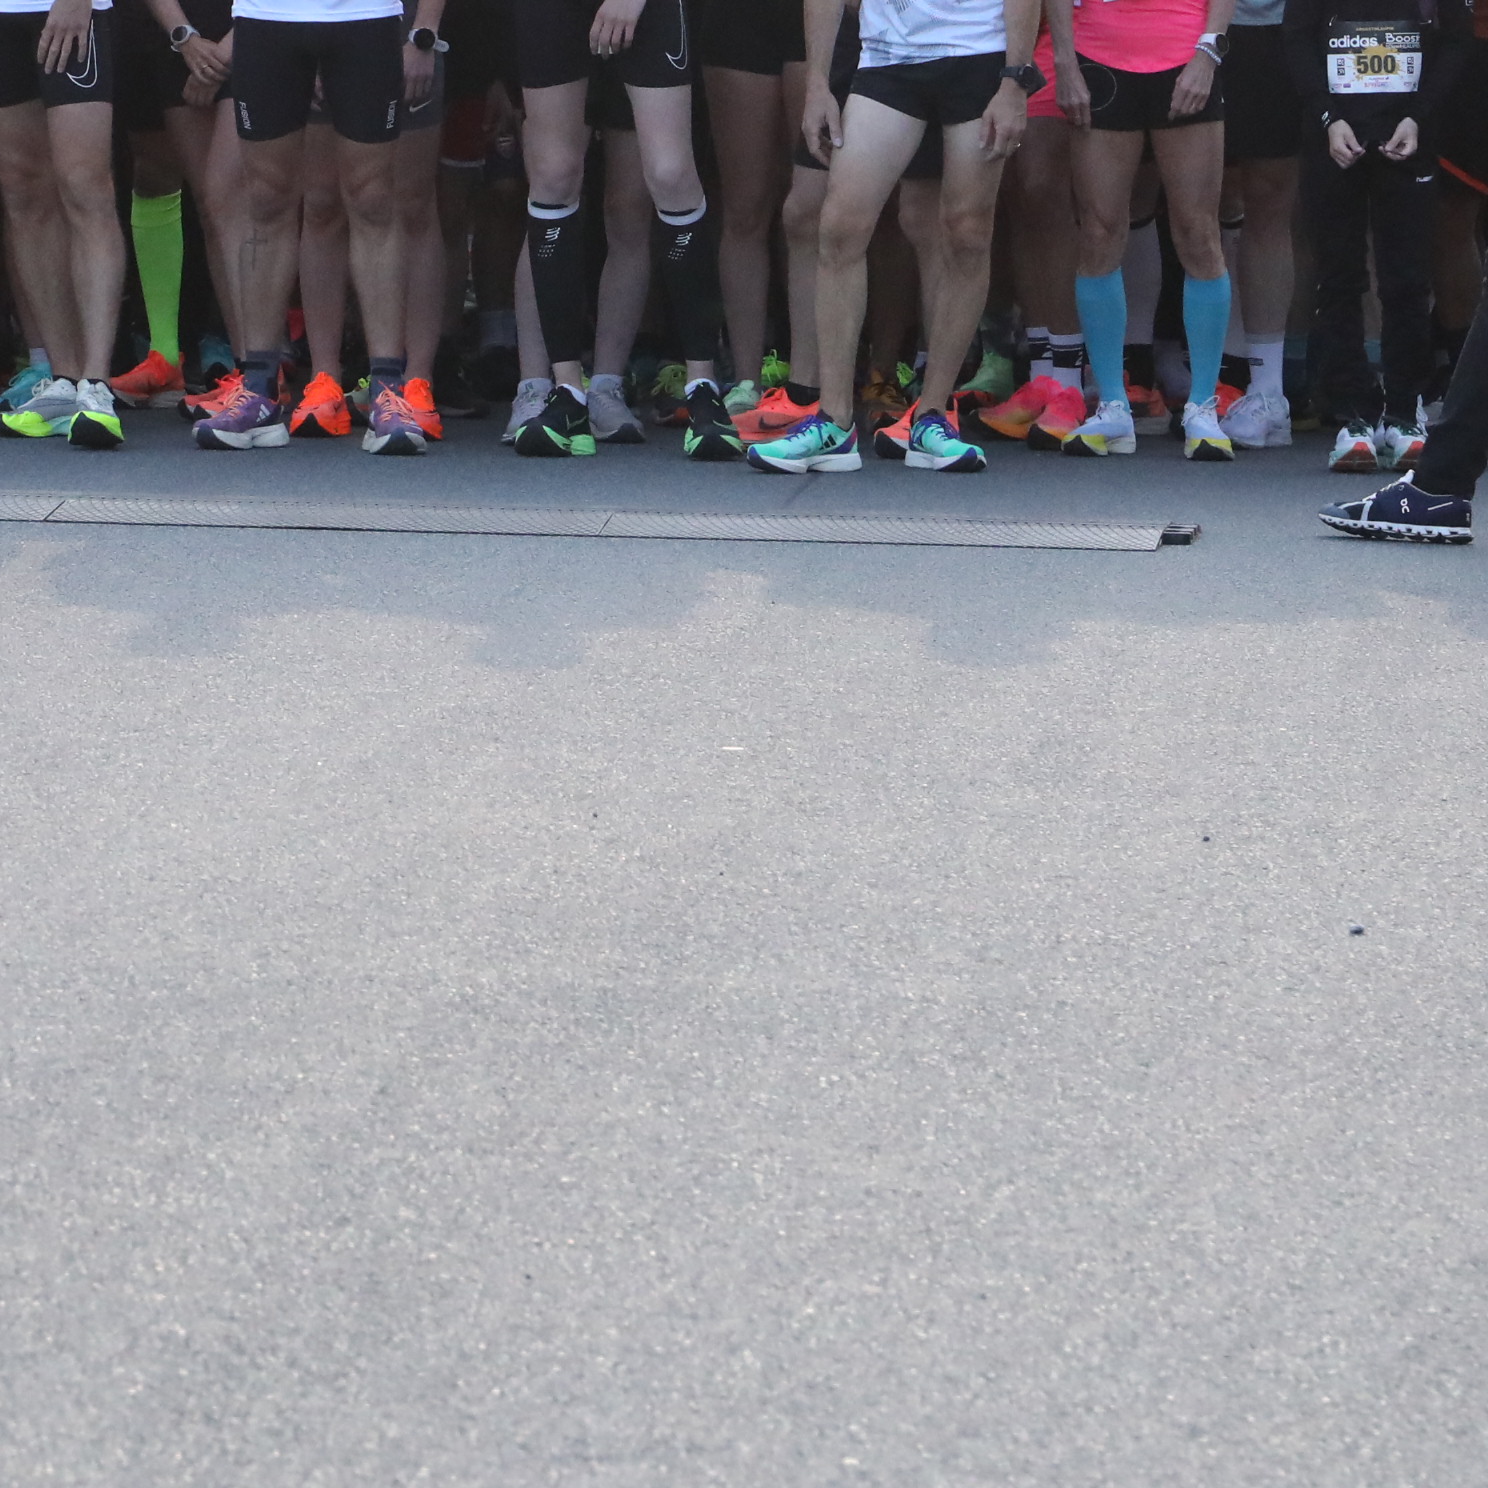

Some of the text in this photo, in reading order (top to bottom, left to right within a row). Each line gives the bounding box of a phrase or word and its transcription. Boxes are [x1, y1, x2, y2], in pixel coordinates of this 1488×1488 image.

[1329, 35, 1379, 48] adidas
[1385, 33, 1420, 43] Boost
[1356, 55, 1396, 74] 500
